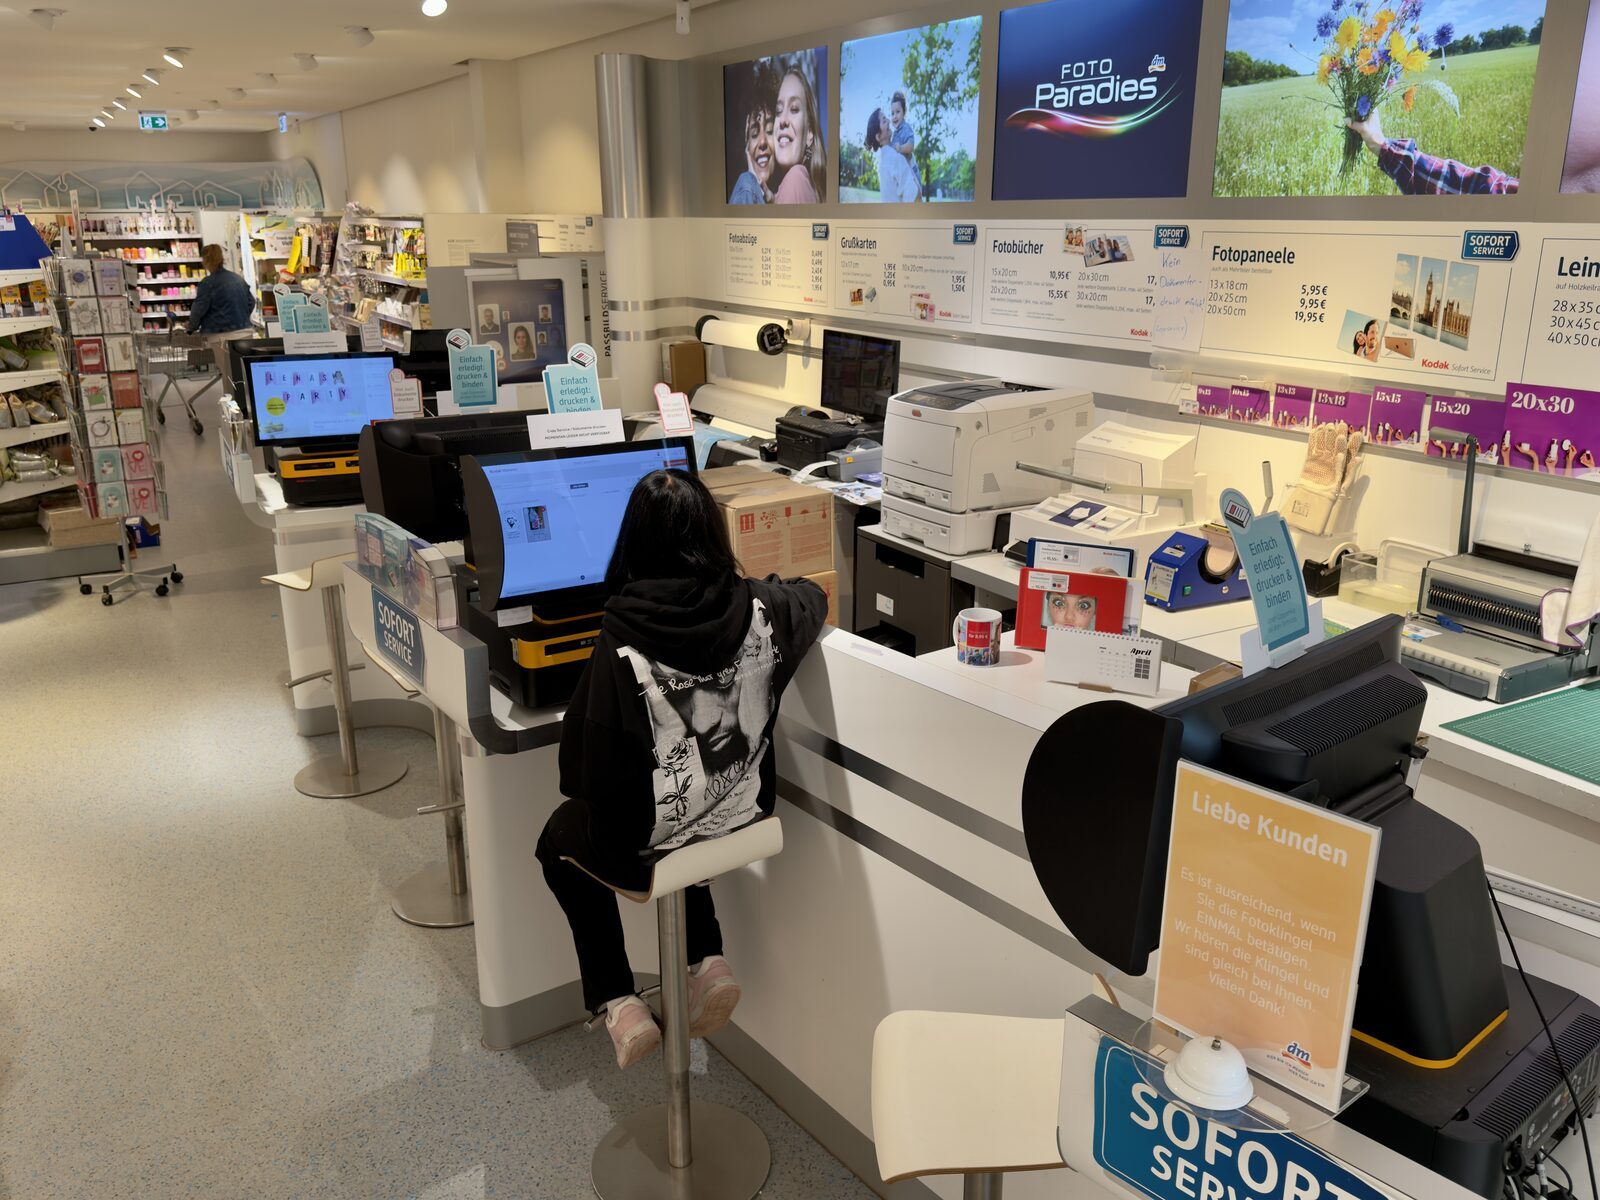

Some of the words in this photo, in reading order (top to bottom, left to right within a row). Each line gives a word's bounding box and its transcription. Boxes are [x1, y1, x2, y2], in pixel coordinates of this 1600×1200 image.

[1061, 59, 1112, 79] FOTO
[1035, 75, 1157, 108] Paradies
[729, 232, 757, 246] Fotoabzüge
[1158, 228, 1184, 238] SOFORT
[1469, 234, 1511, 246] SOFORT
[841, 237, 876, 249] Grußkarten
[992, 240, 1044, 254] Fotobücher
[1472, 246, 1504, 255] SERVICE
[1162, 252, 1180, 267] Kein
[1212, 246, 1295, 266] Fotopaneele
[1558, 256, 1600, 277] Lein
[1147, 276, 1157, 286] 17,
[1146, 296, 1155, 307] 17,
[1422, 358, 1449, 370] Kodak
[1451, 362, 1469, 373] Sofort
[1471, 365, 1491, 375] Service
[560, 377, 588, 385] Einfach
[1277, 386, 1296, 395] 13x13
[559, 397, 588, 405] drucken
[560, 387, 591, 396] erledigt:
[1318, 393, 1346, 406] 13x18
[1375, 391, 1401, 404] 15x15
[1435, 401, 1470, 416] 15x20
[1511, 391, 1575, 414] 20x30
[1249, 537, 1278, 556] Einfach
[1254, 553, 1286, 574] erledigt:
[1256, 573, 1286, 592] drucken
[1287, 569, 1293, 582] &
[1266, 589, 1291, 608] binden
[378, 602, 414, 648] SOFORT
[384, 632, 413, 666] SERVICE
[1192, 791, 1250, 830] Liebe
[1257, 815, 1348, 867] Kunden
[1181, 866, 1194, 881] Es
[1198, 873, 1212, 890] ist
[1215, 883, 1295, 927] ausreichend,
[1300, 920, 1336, 942] wenn
[1197, 892, 1215, 909] Sie
[1219, 903, 1237, 919] die
[1241, 911, 1312, 952] Fotoklingel
[1197, 910, 1242, 940] EINMAL
[1248, 932, 1311, 972] betätigen.
[1184, 943, 1209, 963] sind
[1212, 956, 1249, 981] gleich
[1252, 972, 1272, 991] bei
[1194, 928, 1229, 952] hören
[1233, 947, 1251, 963] die
[1256, 955, 1299, 986] Klingel
[1304, 979, 1329, 999] und
[1209, 971, 1246, 998] Vielen
[1249, 990, 1285, 1017] Dank!
[1287, 1042, 1310, 1061] dm
